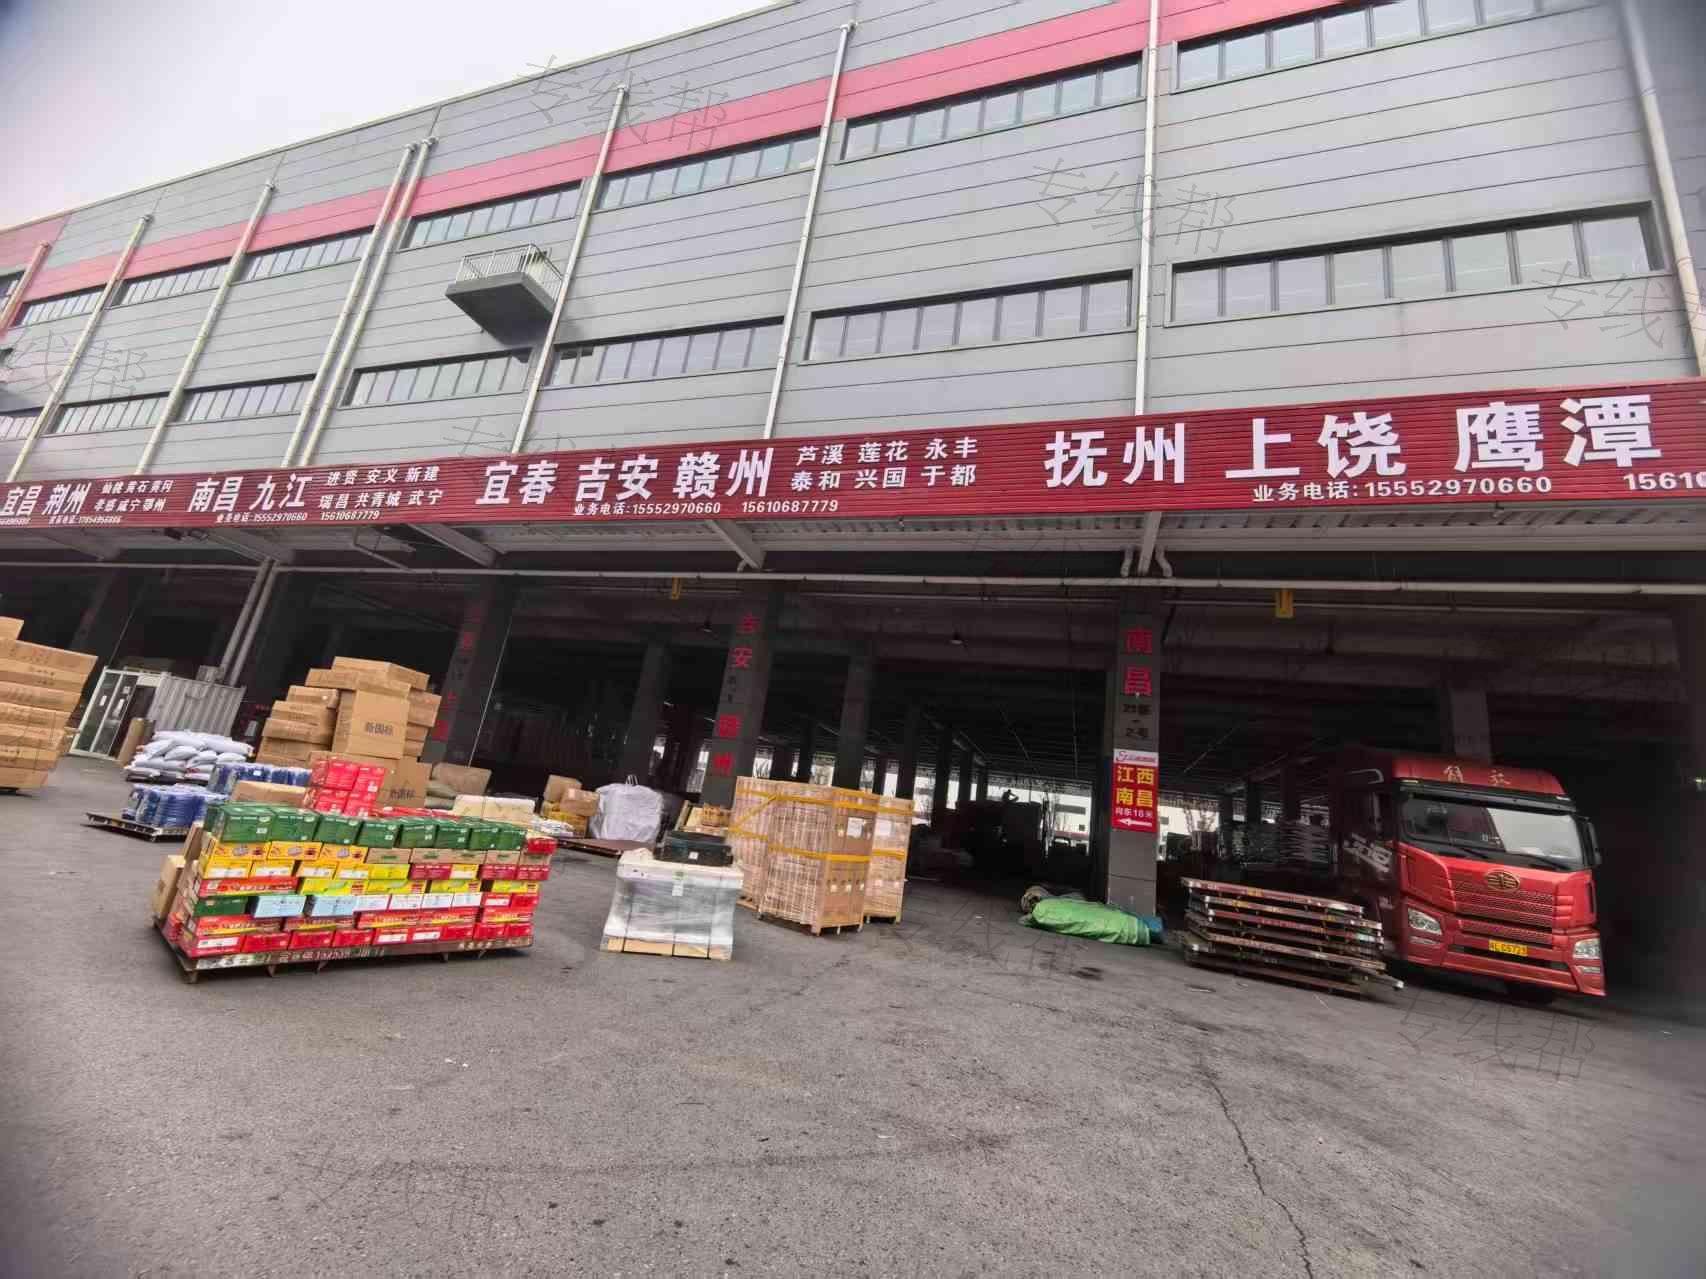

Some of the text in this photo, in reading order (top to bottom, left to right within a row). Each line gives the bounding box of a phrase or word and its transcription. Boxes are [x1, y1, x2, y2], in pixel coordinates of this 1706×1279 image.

[798, 436, 978, 466] 芦溪 莲花 永丰
[1044, 395, 1662, 487] 抚州 上饶 鹰潭
[367, 468, 397, 484] 安义
[405, 466, 440, 483] 新建
[475, 447, 773, 504] 宜春 吉安 赣州
[791, 463, 976, 491] 泰和 兴国 于都
[42, 481, 92, 515] 荆州
[187, 473, 312, 512] 南昌 九江
[408, 489, 443, 505] 武宁
[741, 499, 839, 513] 15610687779
[1116, 766, 1155, 785] 江西
[1115, 788, 1154, 808] 南昌
